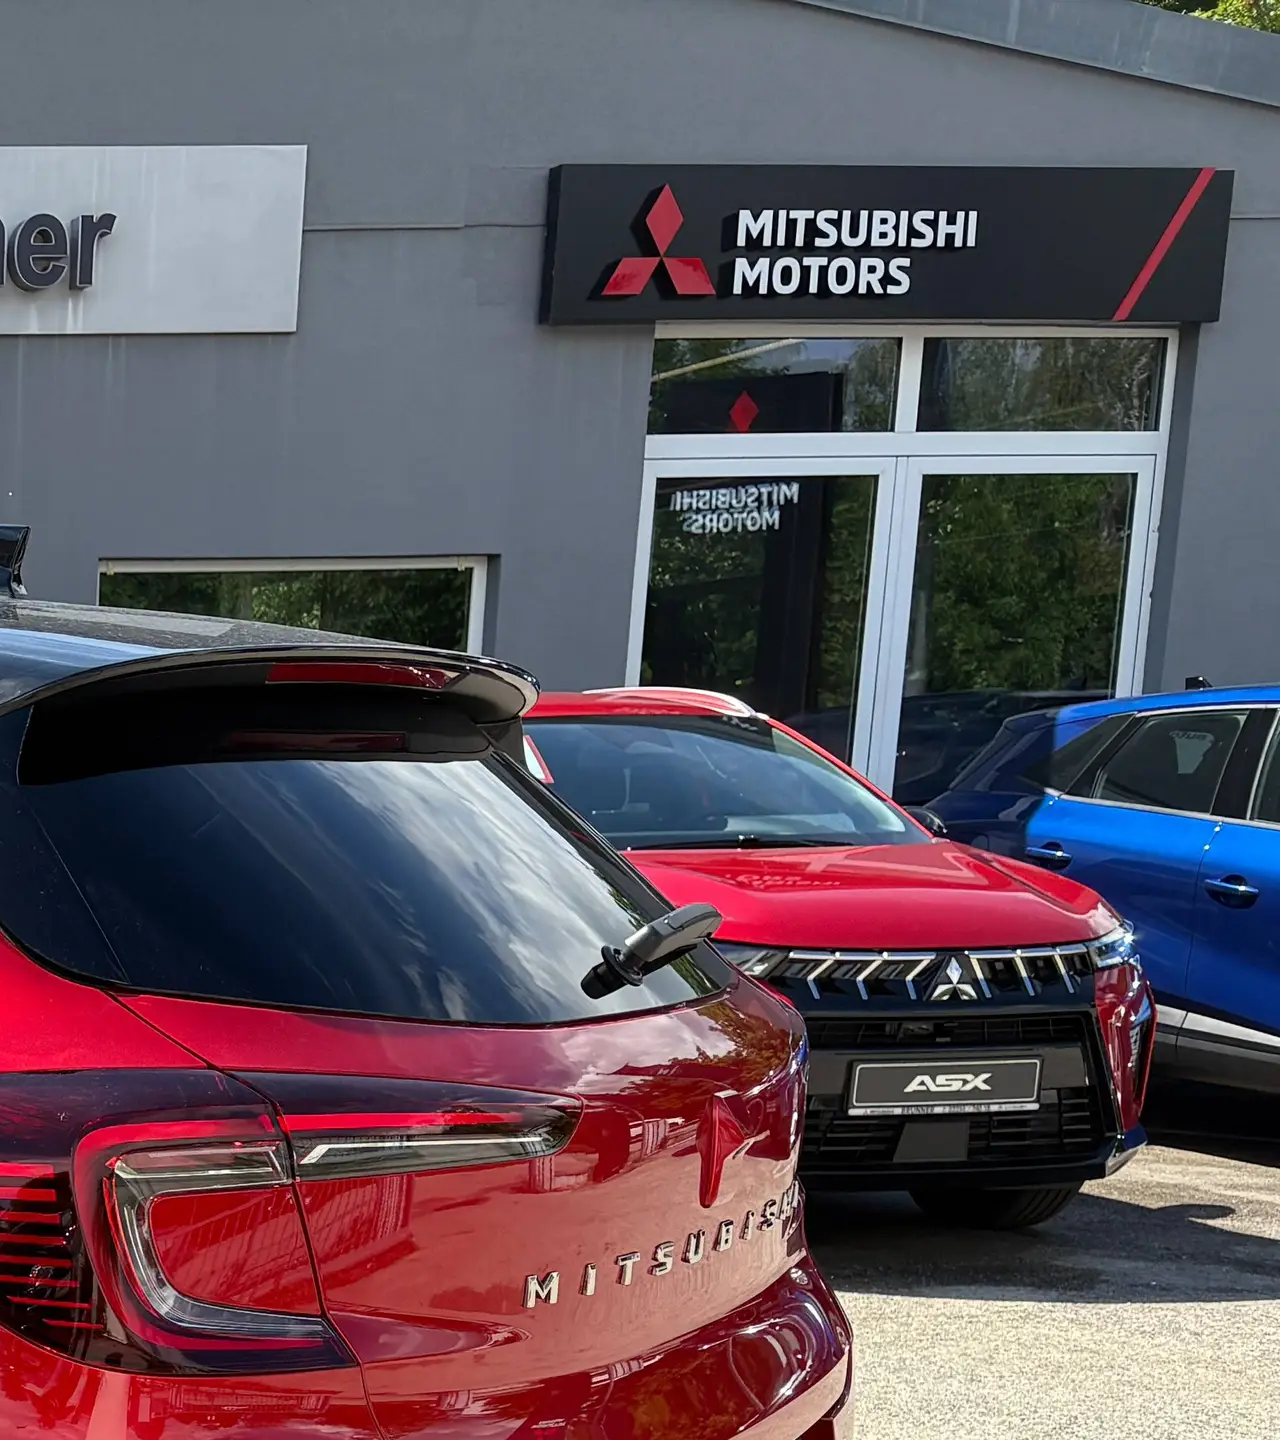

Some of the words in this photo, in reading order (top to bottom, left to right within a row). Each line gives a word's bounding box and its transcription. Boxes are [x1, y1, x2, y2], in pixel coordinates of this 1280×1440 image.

[736, 209, 978, 248] MITSUBISHI
[732, 257, 912, 295] MOTORS
[903, 1073, 993, 1093] ASX
[525, 1180, 800, 1309] MITSUBISHI
